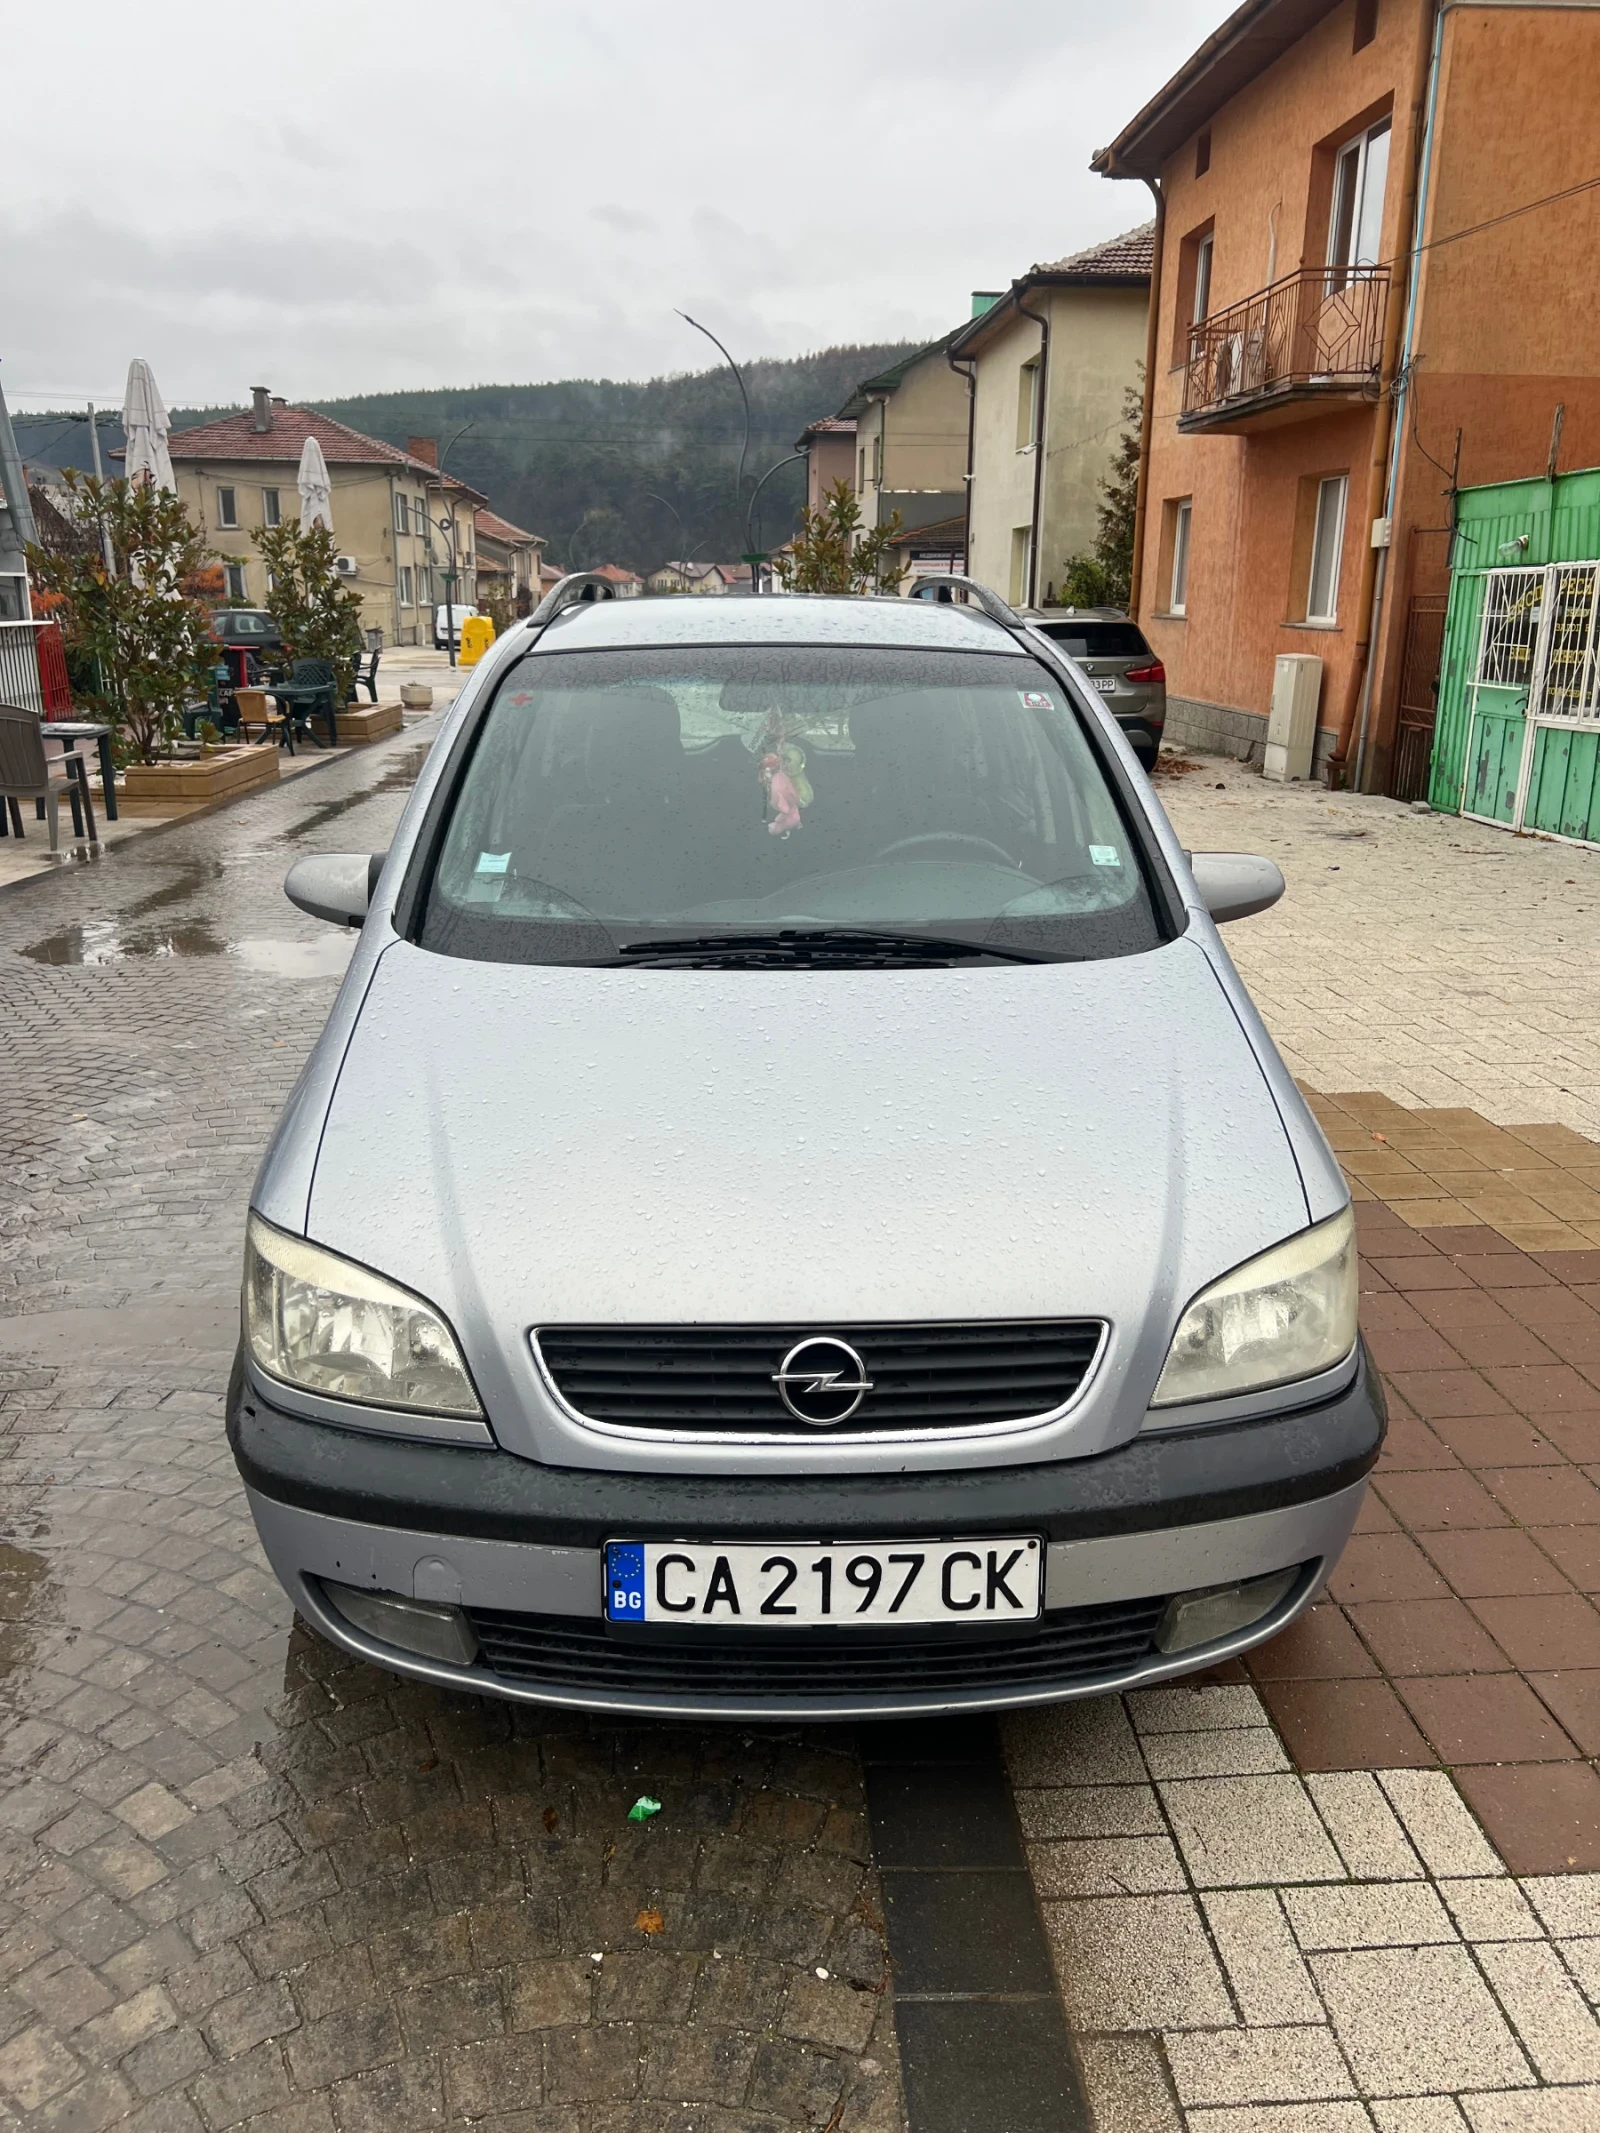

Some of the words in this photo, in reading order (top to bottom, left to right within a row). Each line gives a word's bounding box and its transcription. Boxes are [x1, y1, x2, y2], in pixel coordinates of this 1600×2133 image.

[614, 1590, 642, 1609] BG
[656, 1554, 741, 1614] CA
[760, 1553, 925, 1615] 2197
[941, 1549, 1025, 1612] CK
